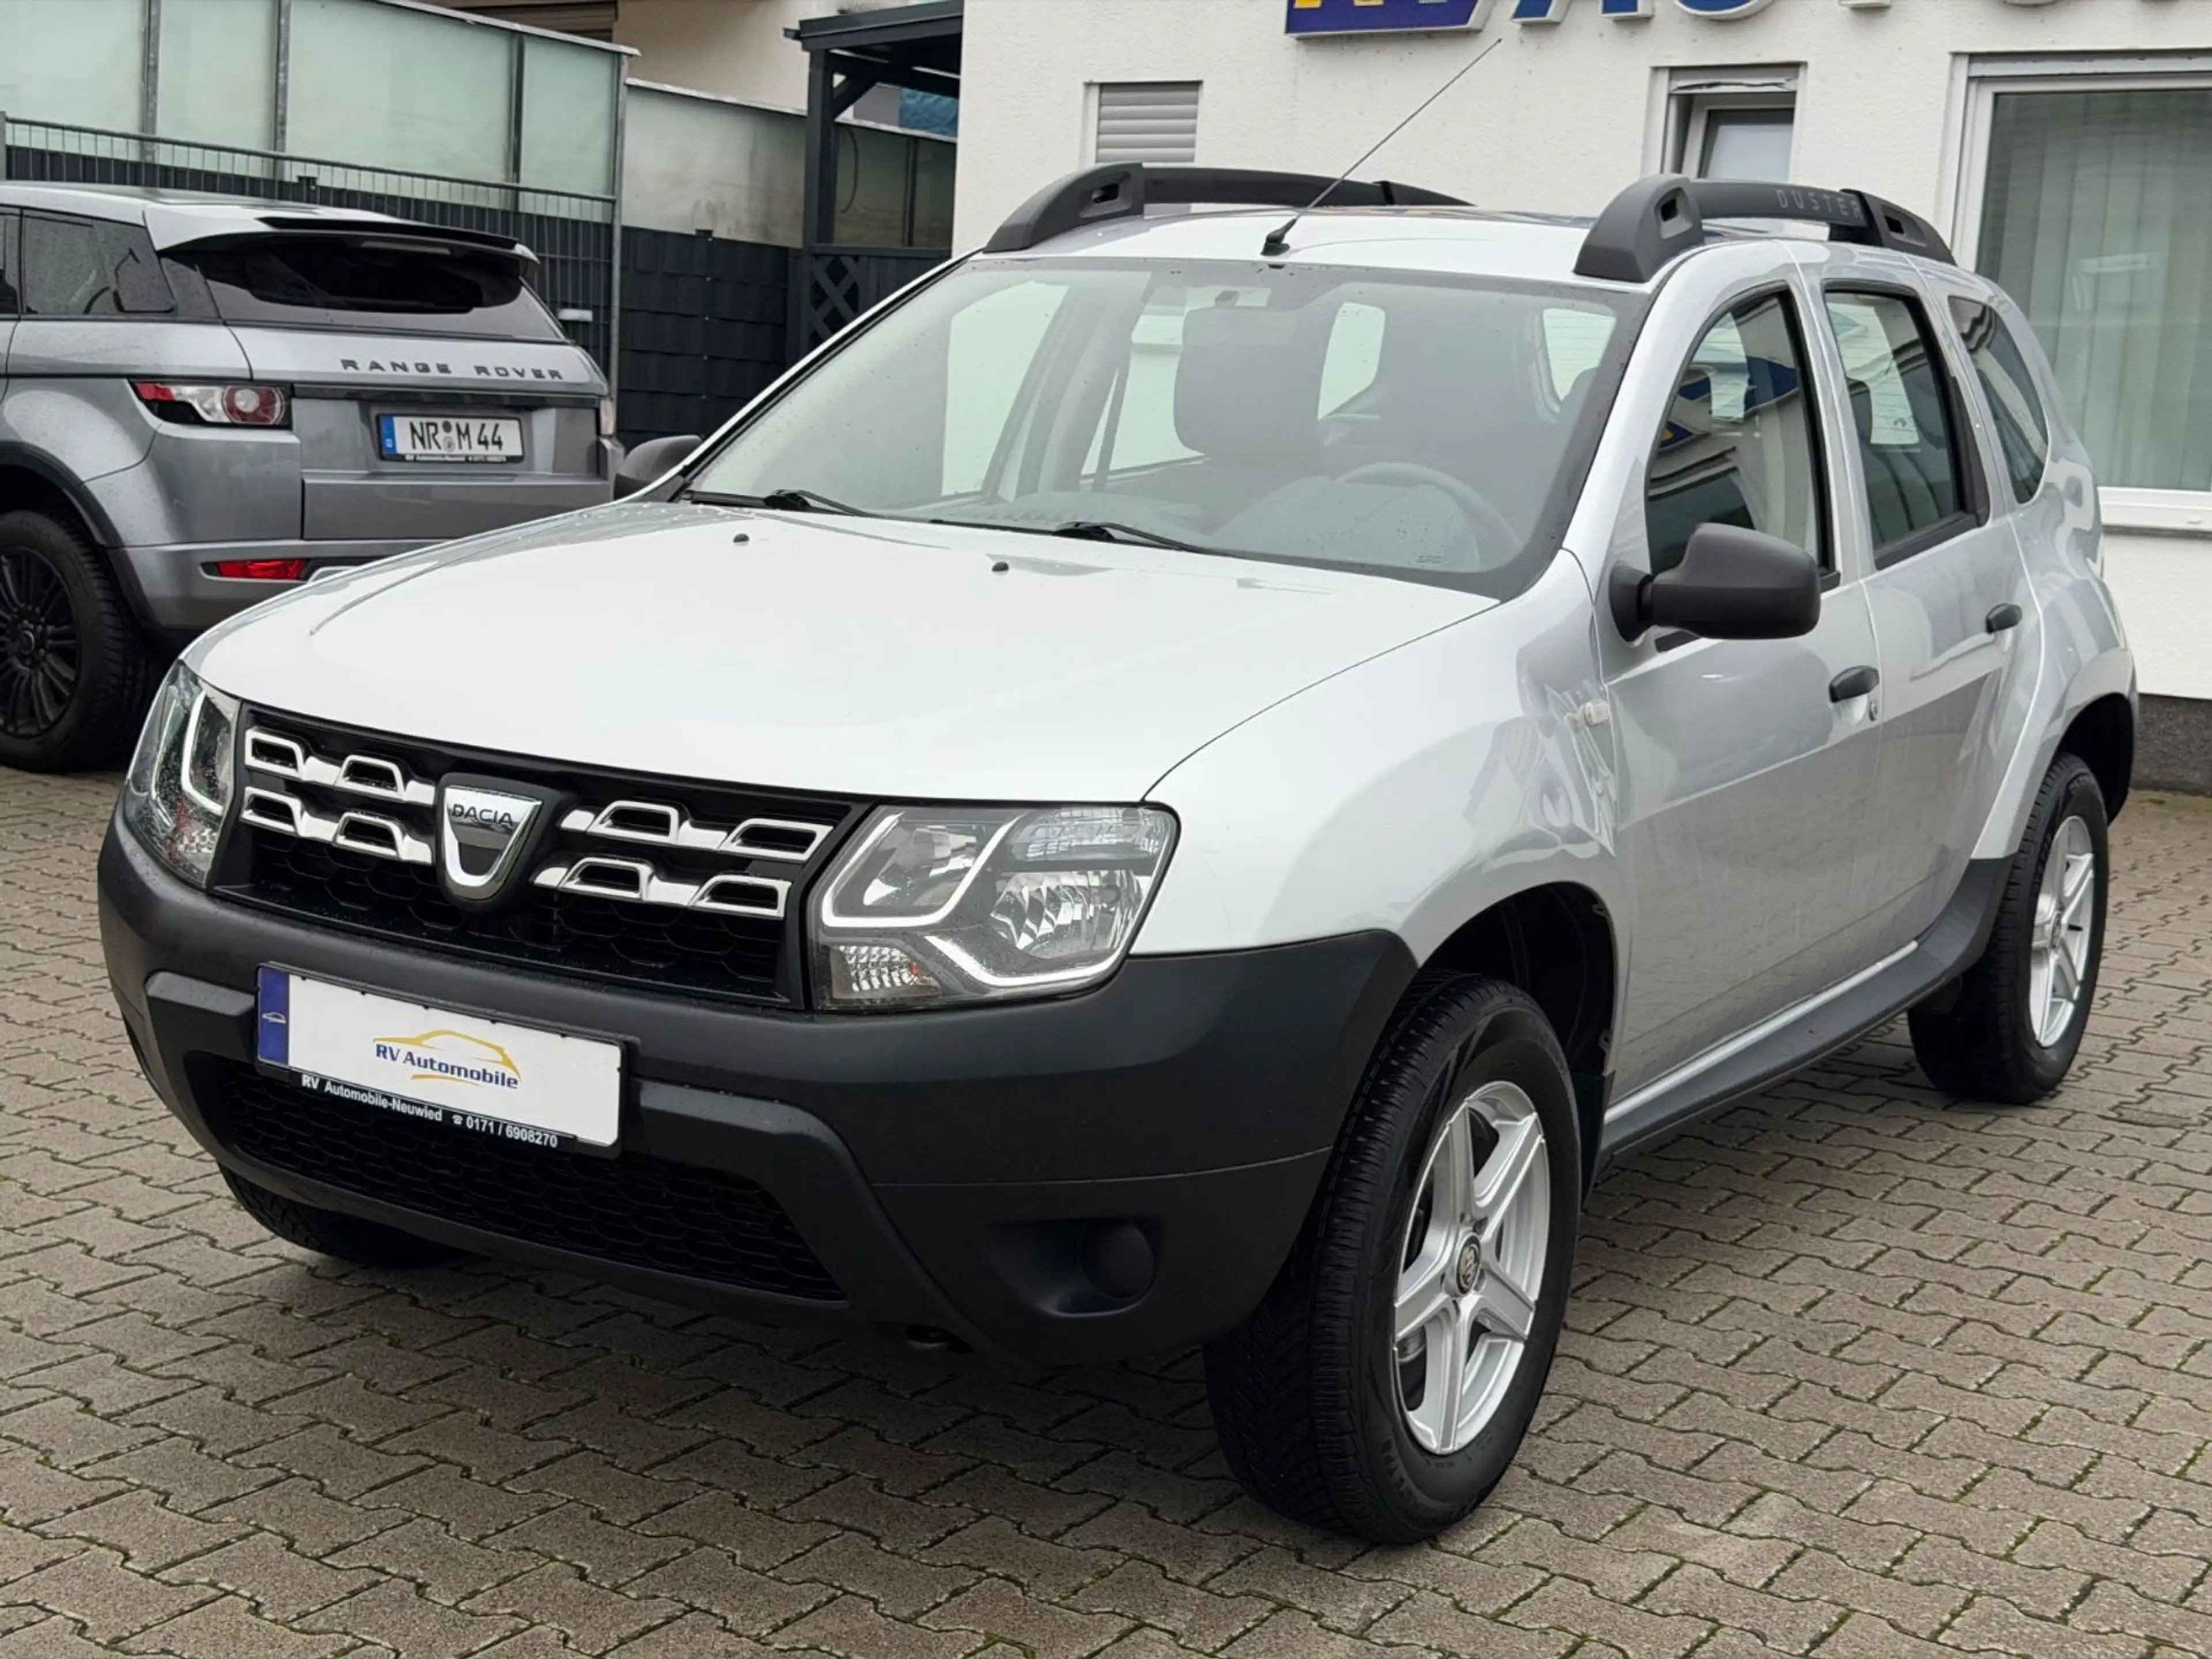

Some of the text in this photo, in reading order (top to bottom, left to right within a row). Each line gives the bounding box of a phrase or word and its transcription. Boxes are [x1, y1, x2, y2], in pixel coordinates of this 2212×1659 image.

[340, 359, 563, 380] RANGE ROVER
[409, 421, 503, 451] NR M 44
[452, 804, 513, 825] DACIA
[375, 1043, 518, 1089] RV Automobile
[301, 1074, 319, 1090] RV
[324, 1079, 442, 1122] Automobile-Neuwied
[465, 1115, 496, 1135] 0171
[505, 1124, 558, 1148] 6908270
